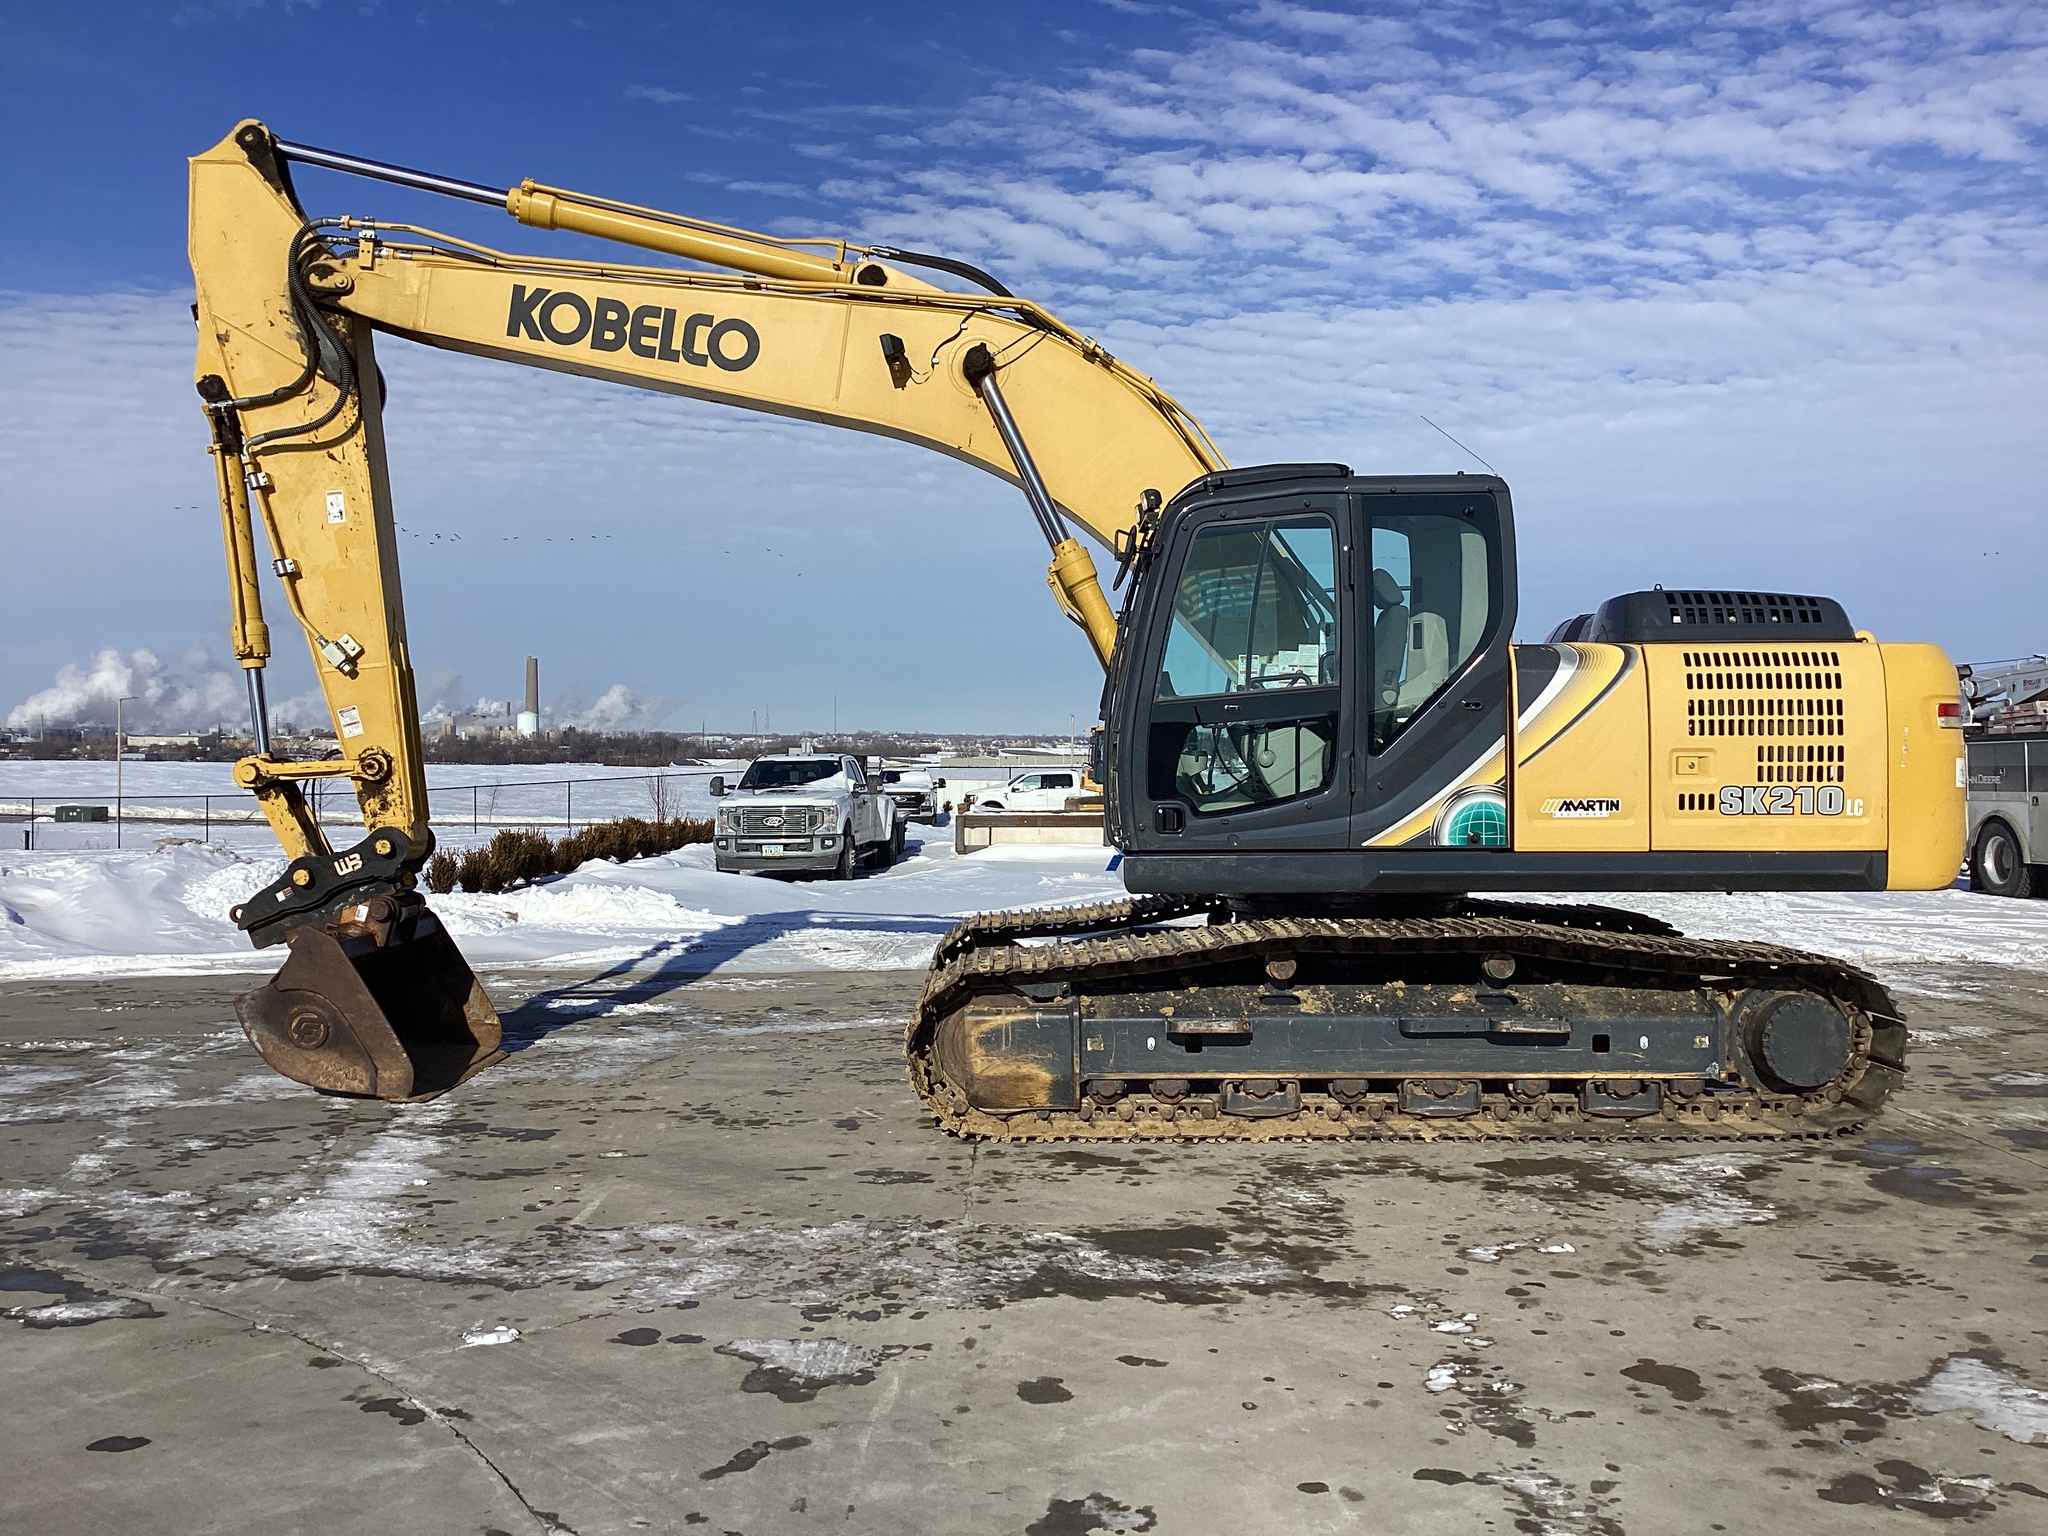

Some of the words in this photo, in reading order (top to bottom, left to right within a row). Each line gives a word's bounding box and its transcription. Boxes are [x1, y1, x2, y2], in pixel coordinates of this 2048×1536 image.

[506, 284, 760, 372] KOBELCO
[1978, 774, 2001, 784] DEERE
[1558, 800, 1620, 811] MARTIN
[1719, 785, 1845, 816] SK210
[1846, 798, 1864, 816] LC
